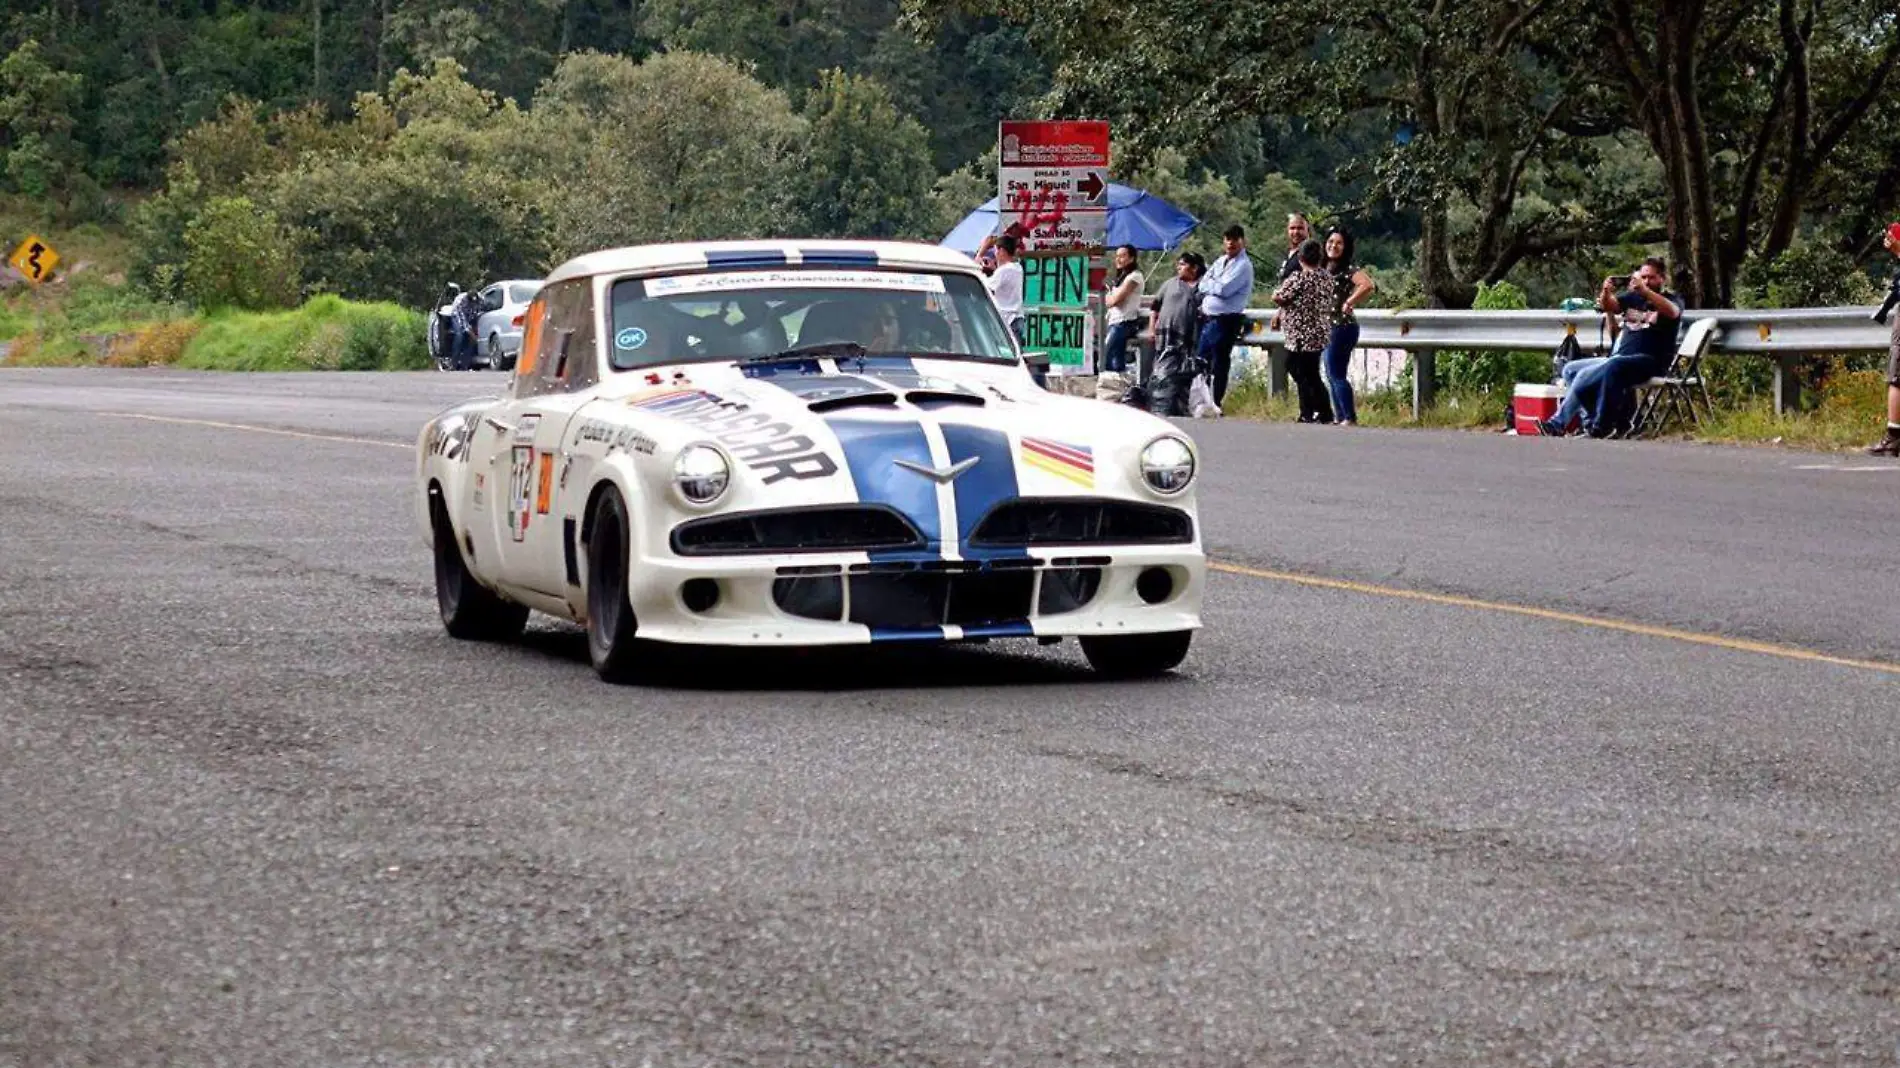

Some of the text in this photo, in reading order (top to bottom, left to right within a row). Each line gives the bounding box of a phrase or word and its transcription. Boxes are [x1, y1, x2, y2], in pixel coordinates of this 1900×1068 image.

[1008, 180, 1071, 193] San Miguel
[1034, 226, 1083, 241] Santiago
[1021, 256, 1085, 302] PAN
[620, 333, 641, 345] OK
[511, 461, 532, 500] 112
